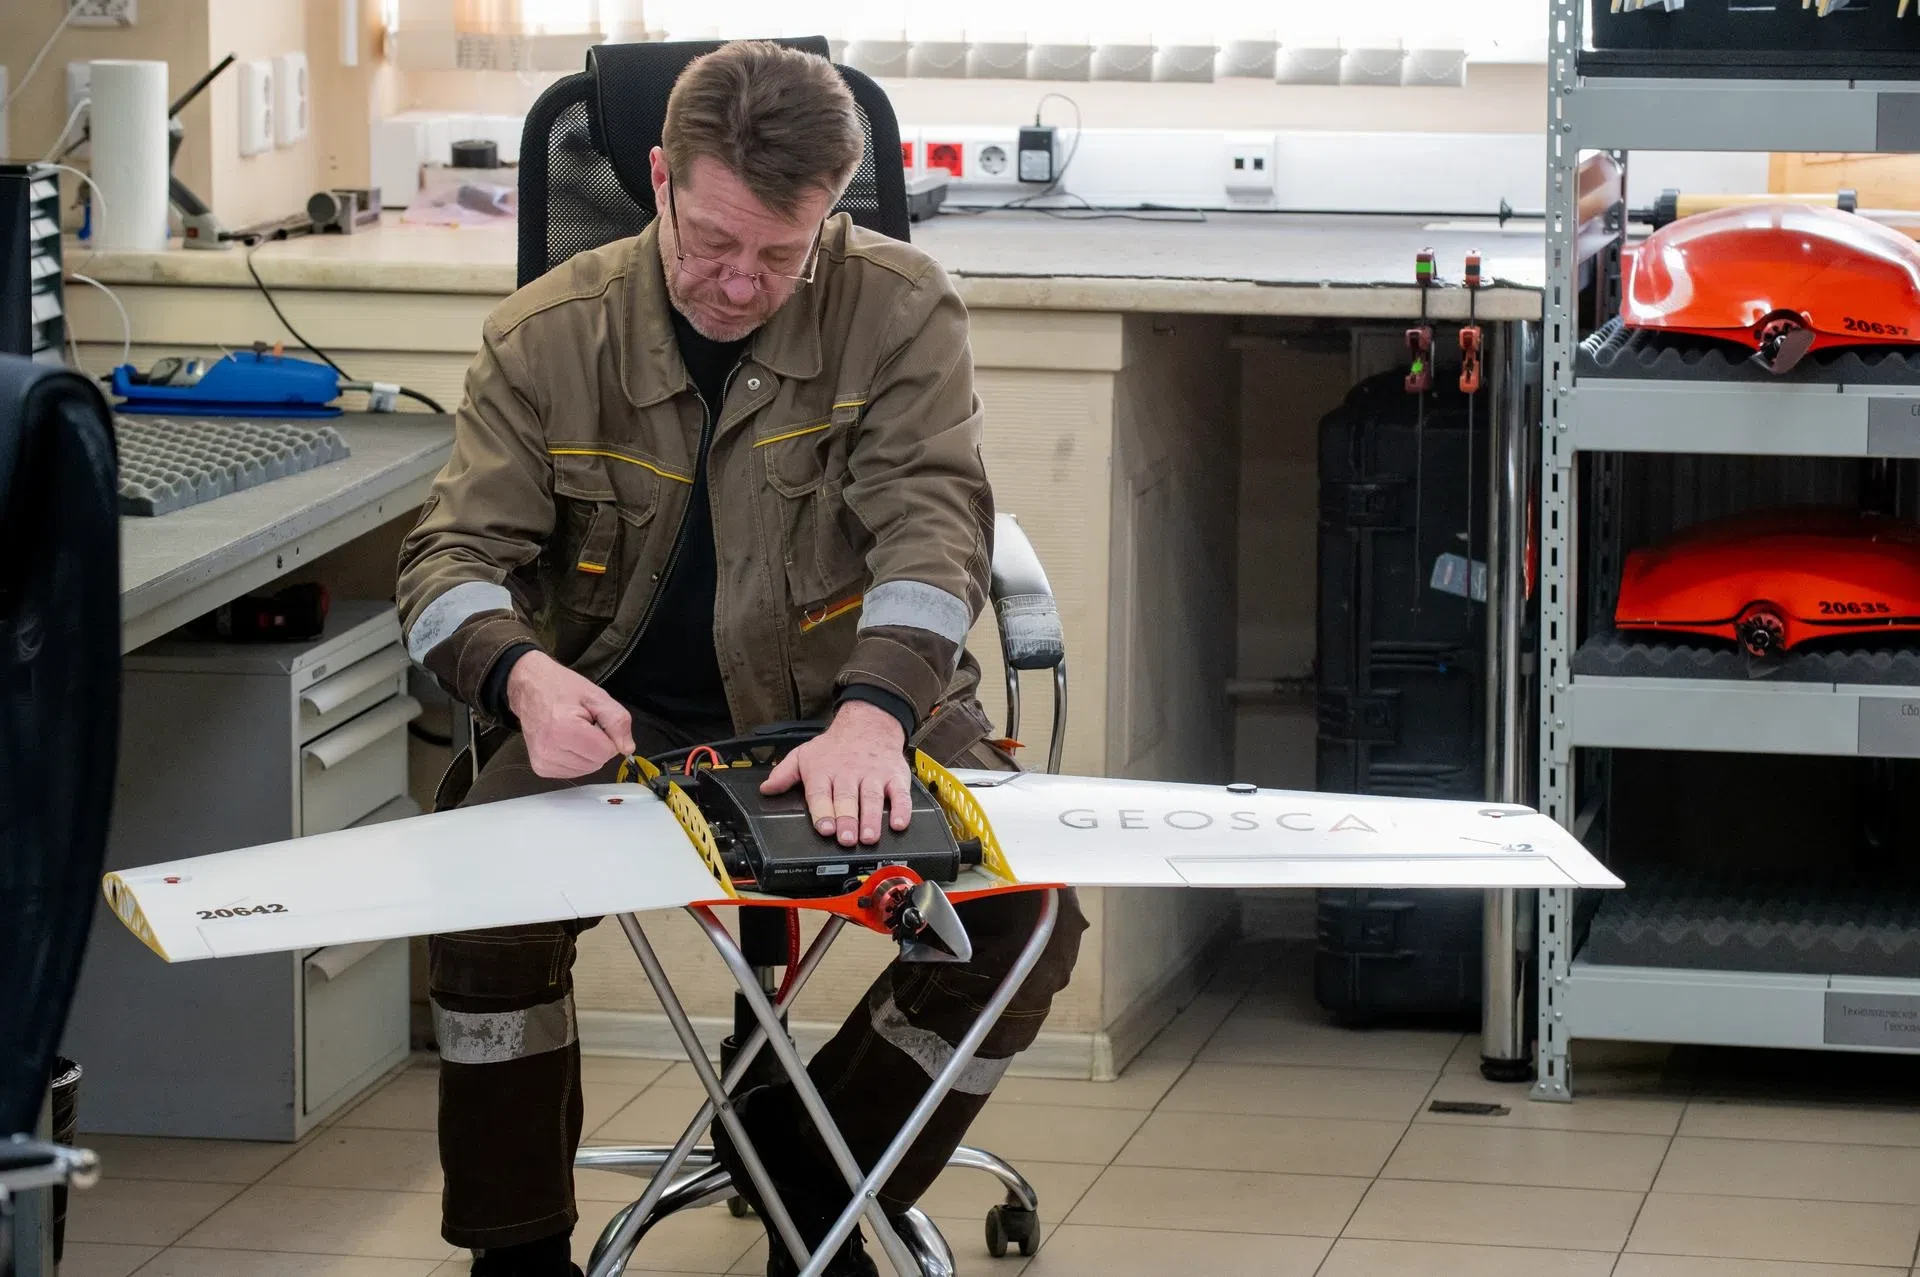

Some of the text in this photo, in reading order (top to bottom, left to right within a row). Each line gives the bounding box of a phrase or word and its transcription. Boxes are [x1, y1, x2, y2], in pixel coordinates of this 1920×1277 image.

[1842, 316, 1909, 336] 20637
[1818, 601, 1890, 615] 20635
[1058, 808, 1396, 833] GEOSCA
[195, 903, 289, 920] 20642
